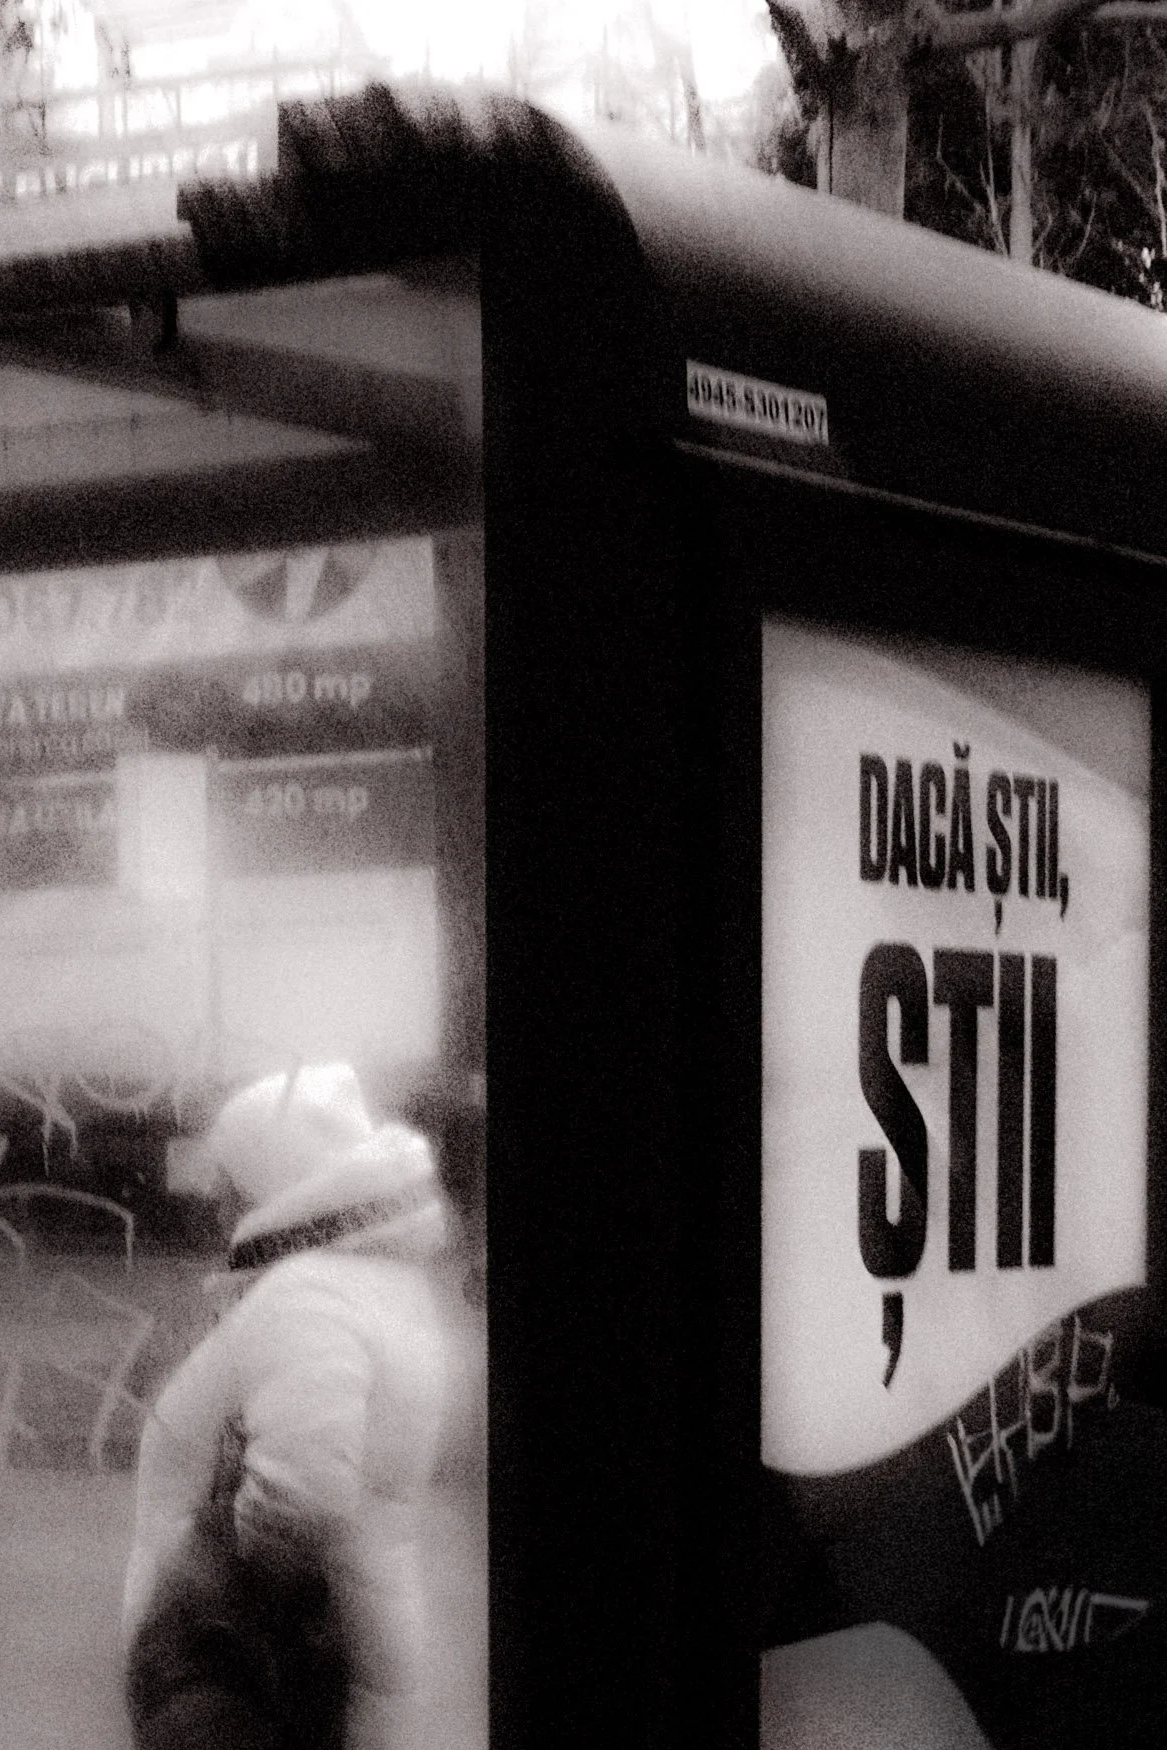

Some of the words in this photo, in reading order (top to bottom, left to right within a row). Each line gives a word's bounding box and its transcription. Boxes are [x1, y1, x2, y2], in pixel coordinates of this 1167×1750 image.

[859, 741, 975, 893] DACĂ
[986, 769, 1069, 935] ȘTII,
[857, 942, 1057, 1390] ȘTII
